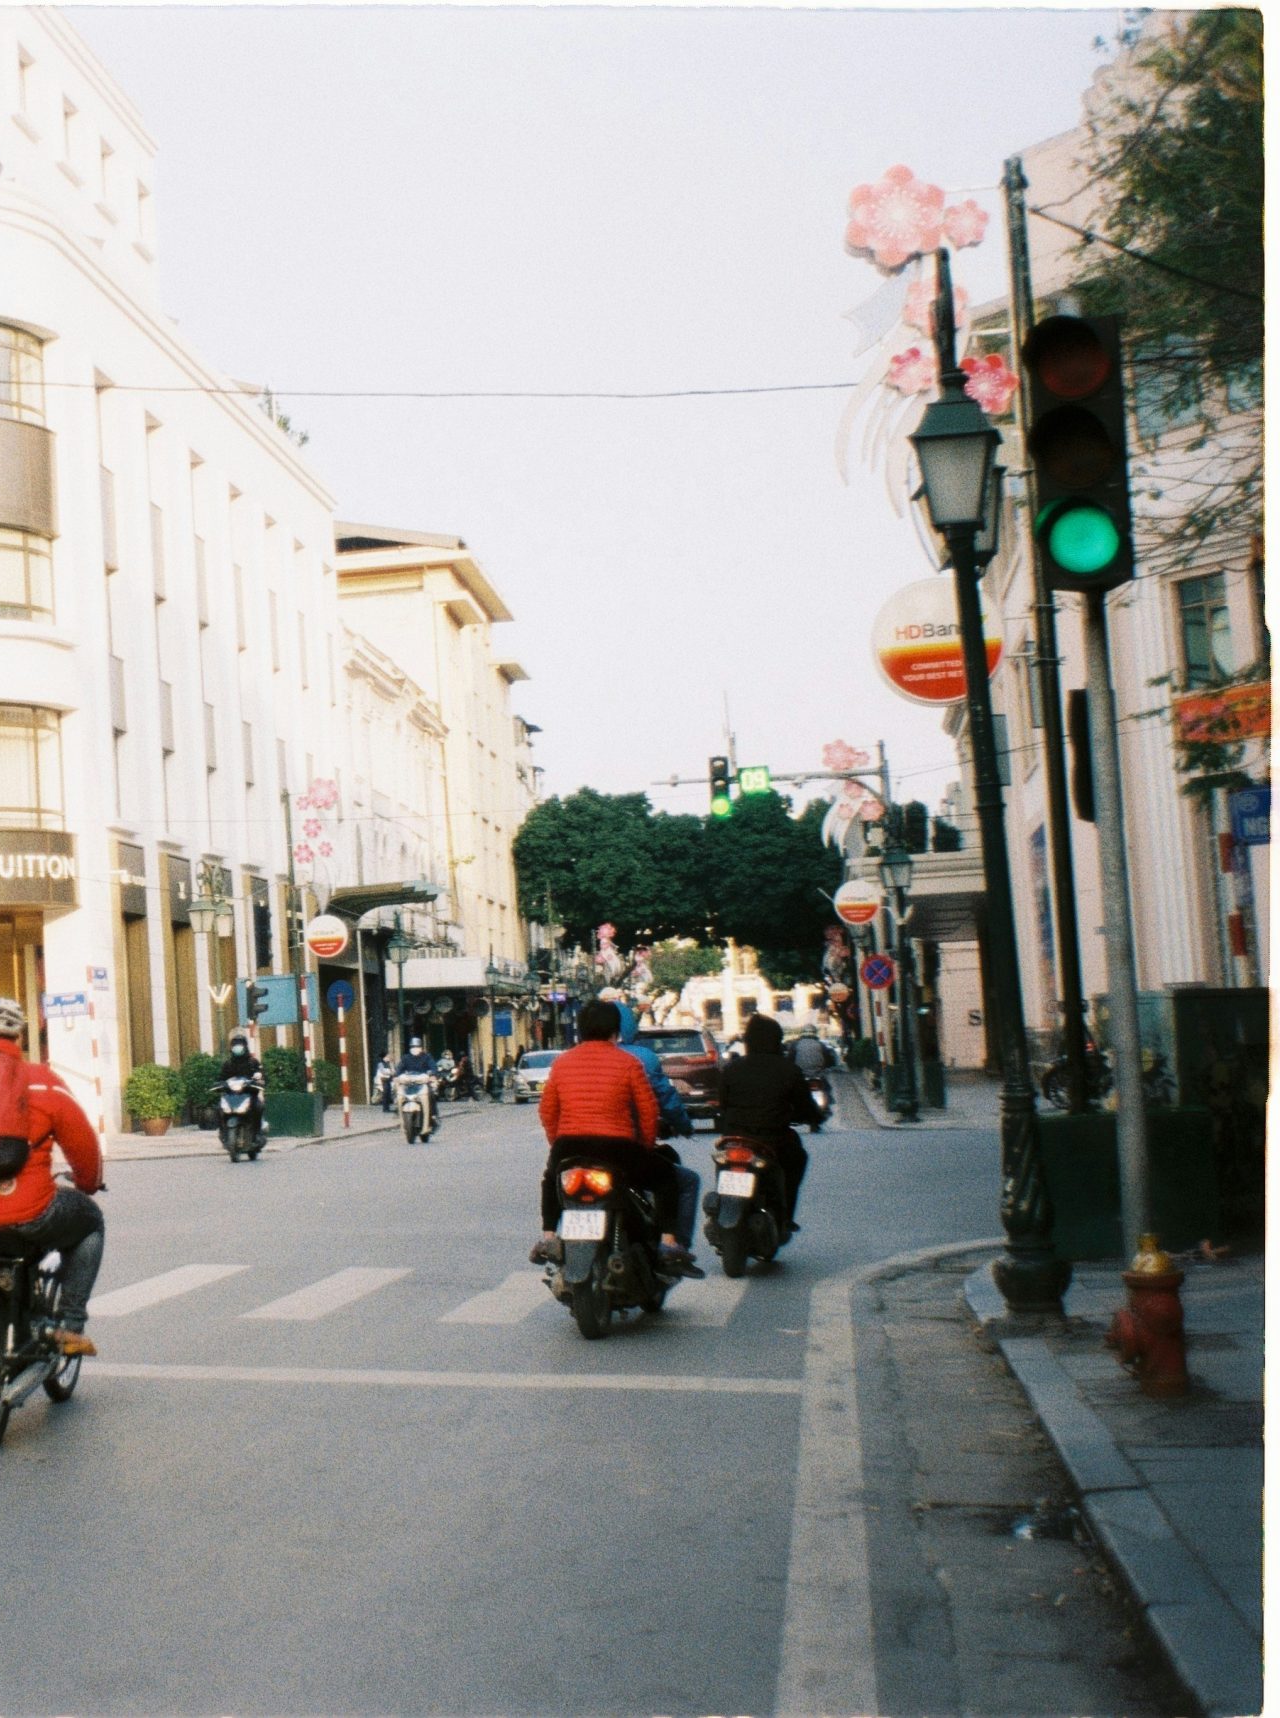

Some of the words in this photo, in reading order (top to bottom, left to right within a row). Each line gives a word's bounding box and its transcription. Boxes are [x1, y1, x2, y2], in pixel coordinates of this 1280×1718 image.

[896, 622, 962, 641] HDBan
[902, 673, 925, 682] YOUR
[926, 671, 946, 680] BEST
